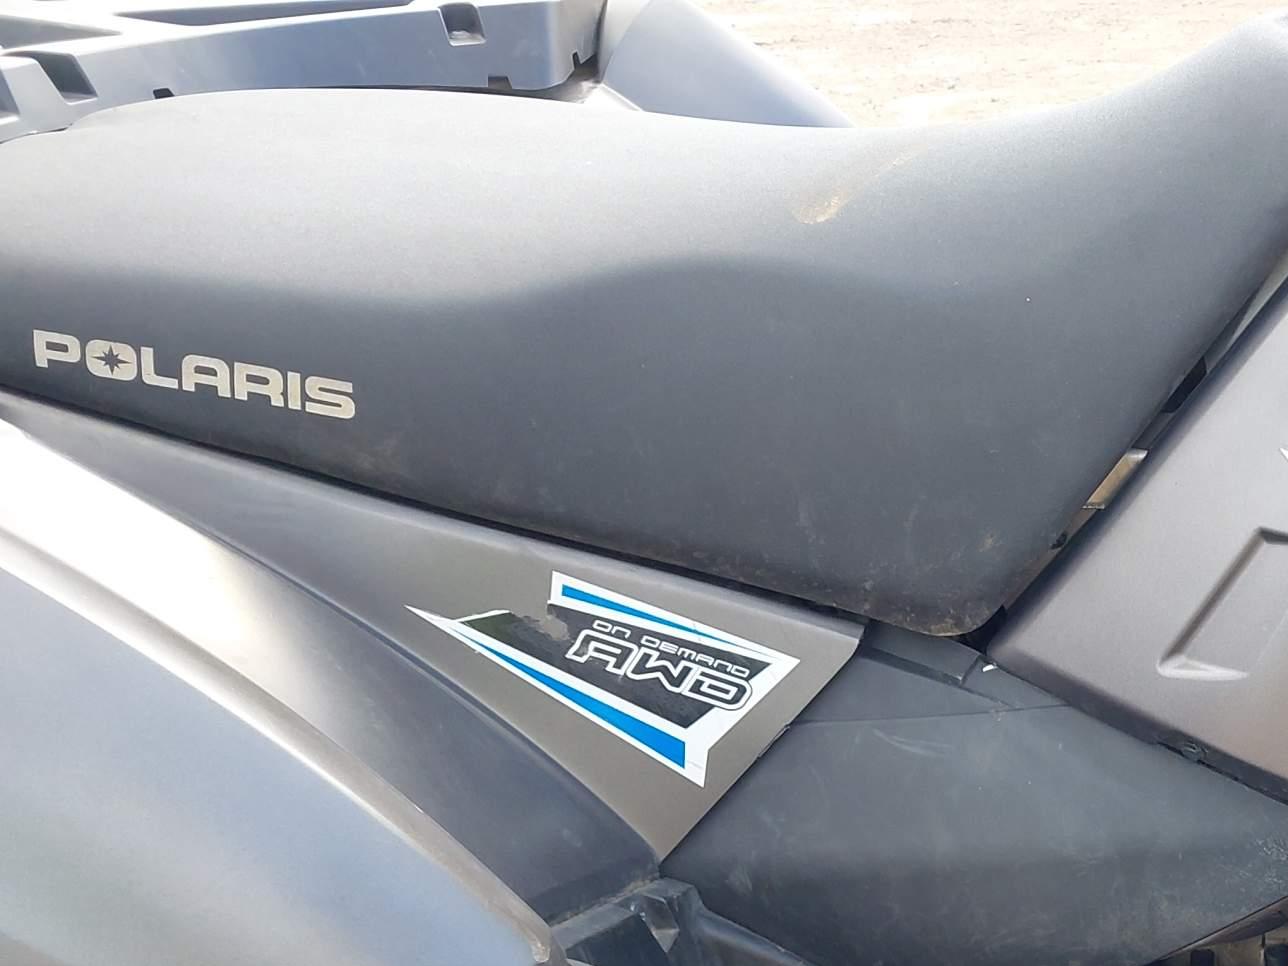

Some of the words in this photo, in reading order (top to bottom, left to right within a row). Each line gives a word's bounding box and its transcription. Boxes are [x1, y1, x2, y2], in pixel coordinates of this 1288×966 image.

[33, 329, 355, 419] POLARIS
[564, 628, 753, 711] AWD
[592, 619, 632, 639] ON
[640, 634, 750, 678] DEMAND
